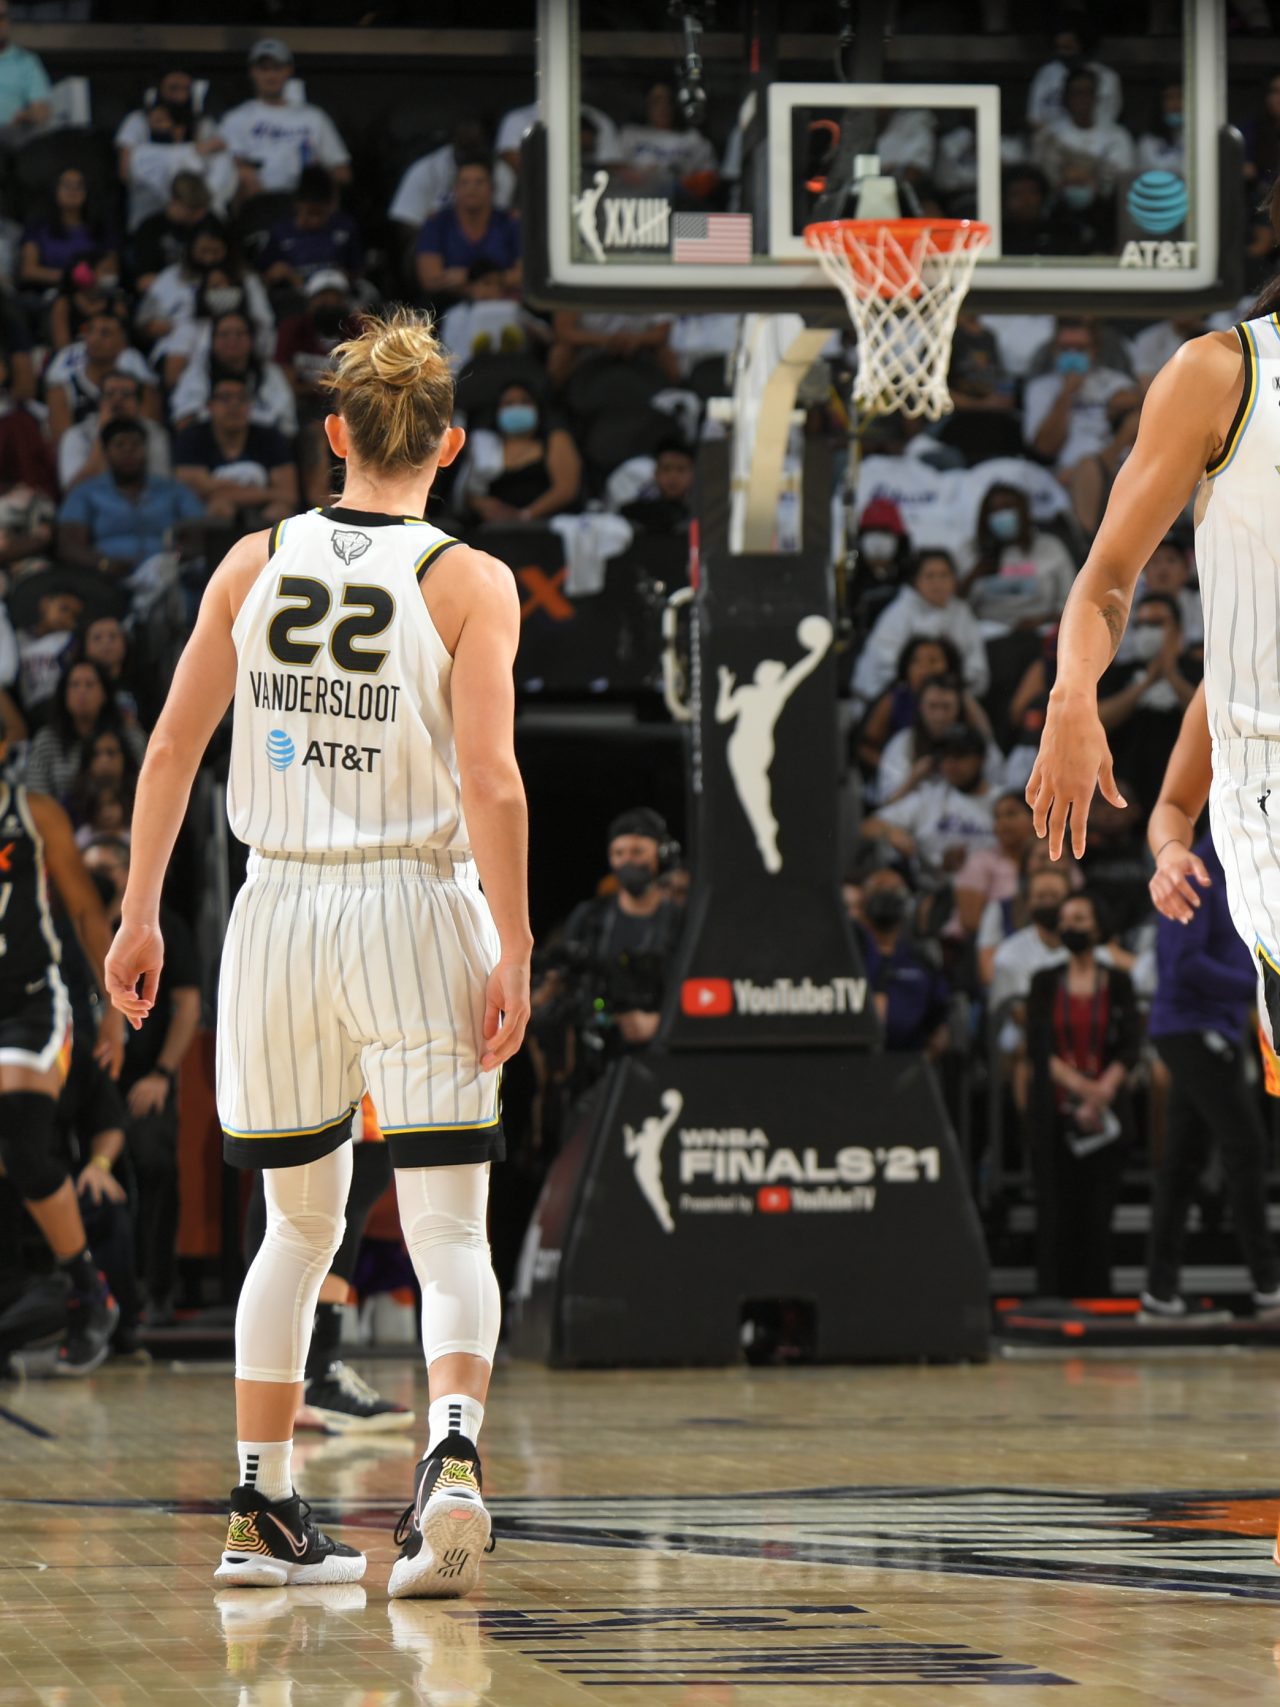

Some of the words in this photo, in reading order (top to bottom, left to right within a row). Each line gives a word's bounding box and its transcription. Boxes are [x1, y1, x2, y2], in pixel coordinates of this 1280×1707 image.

[1120, 240, 1197, 268] AT&T
[267, 574, 396, 675] 22
[250, 671, 400, 722] VANDERSLOOT
[302, 740, 381, 773] AT&T
[680, 1128, 769, 1148] WNBA
[520, 1642, 1079, 1686] 1997
